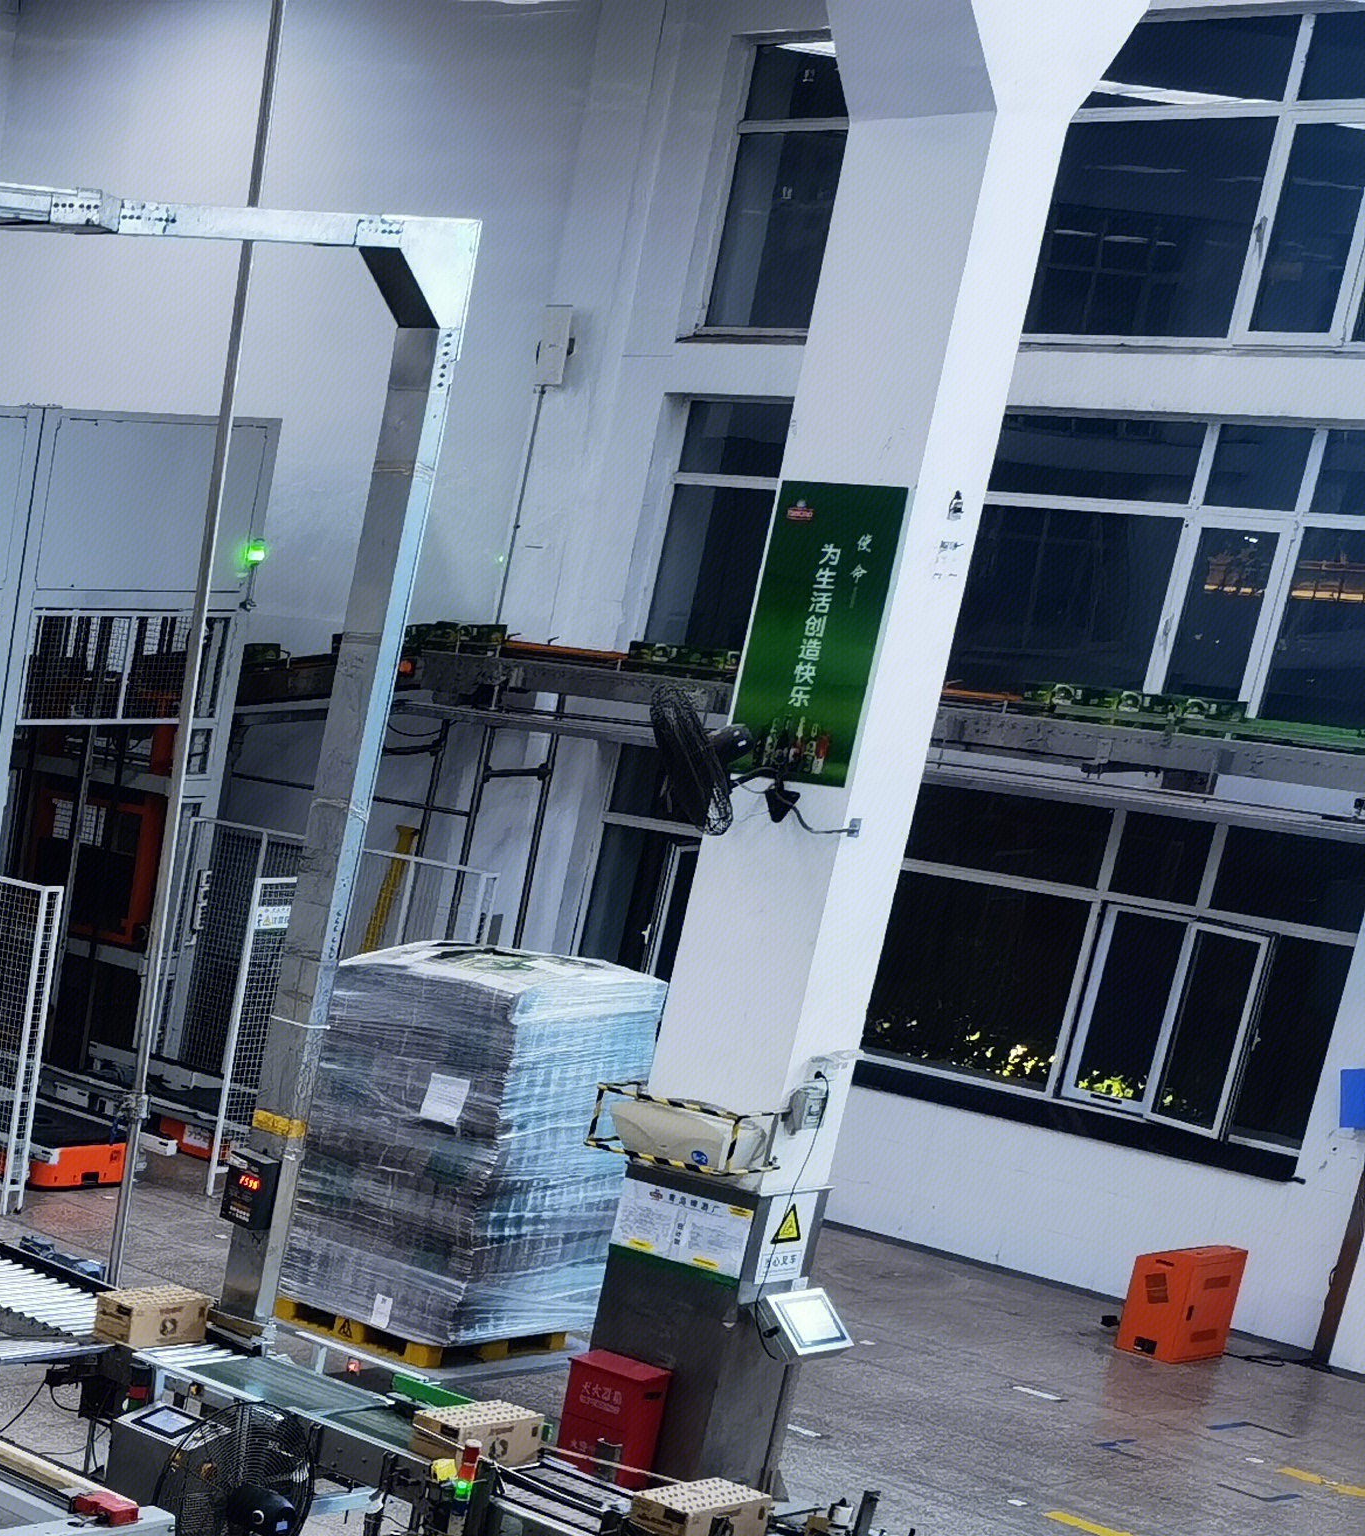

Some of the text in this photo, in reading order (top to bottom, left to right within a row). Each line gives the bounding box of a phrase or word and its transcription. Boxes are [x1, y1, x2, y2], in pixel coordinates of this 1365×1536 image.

[787, 543, 842, 707] 为生活创造快乐
